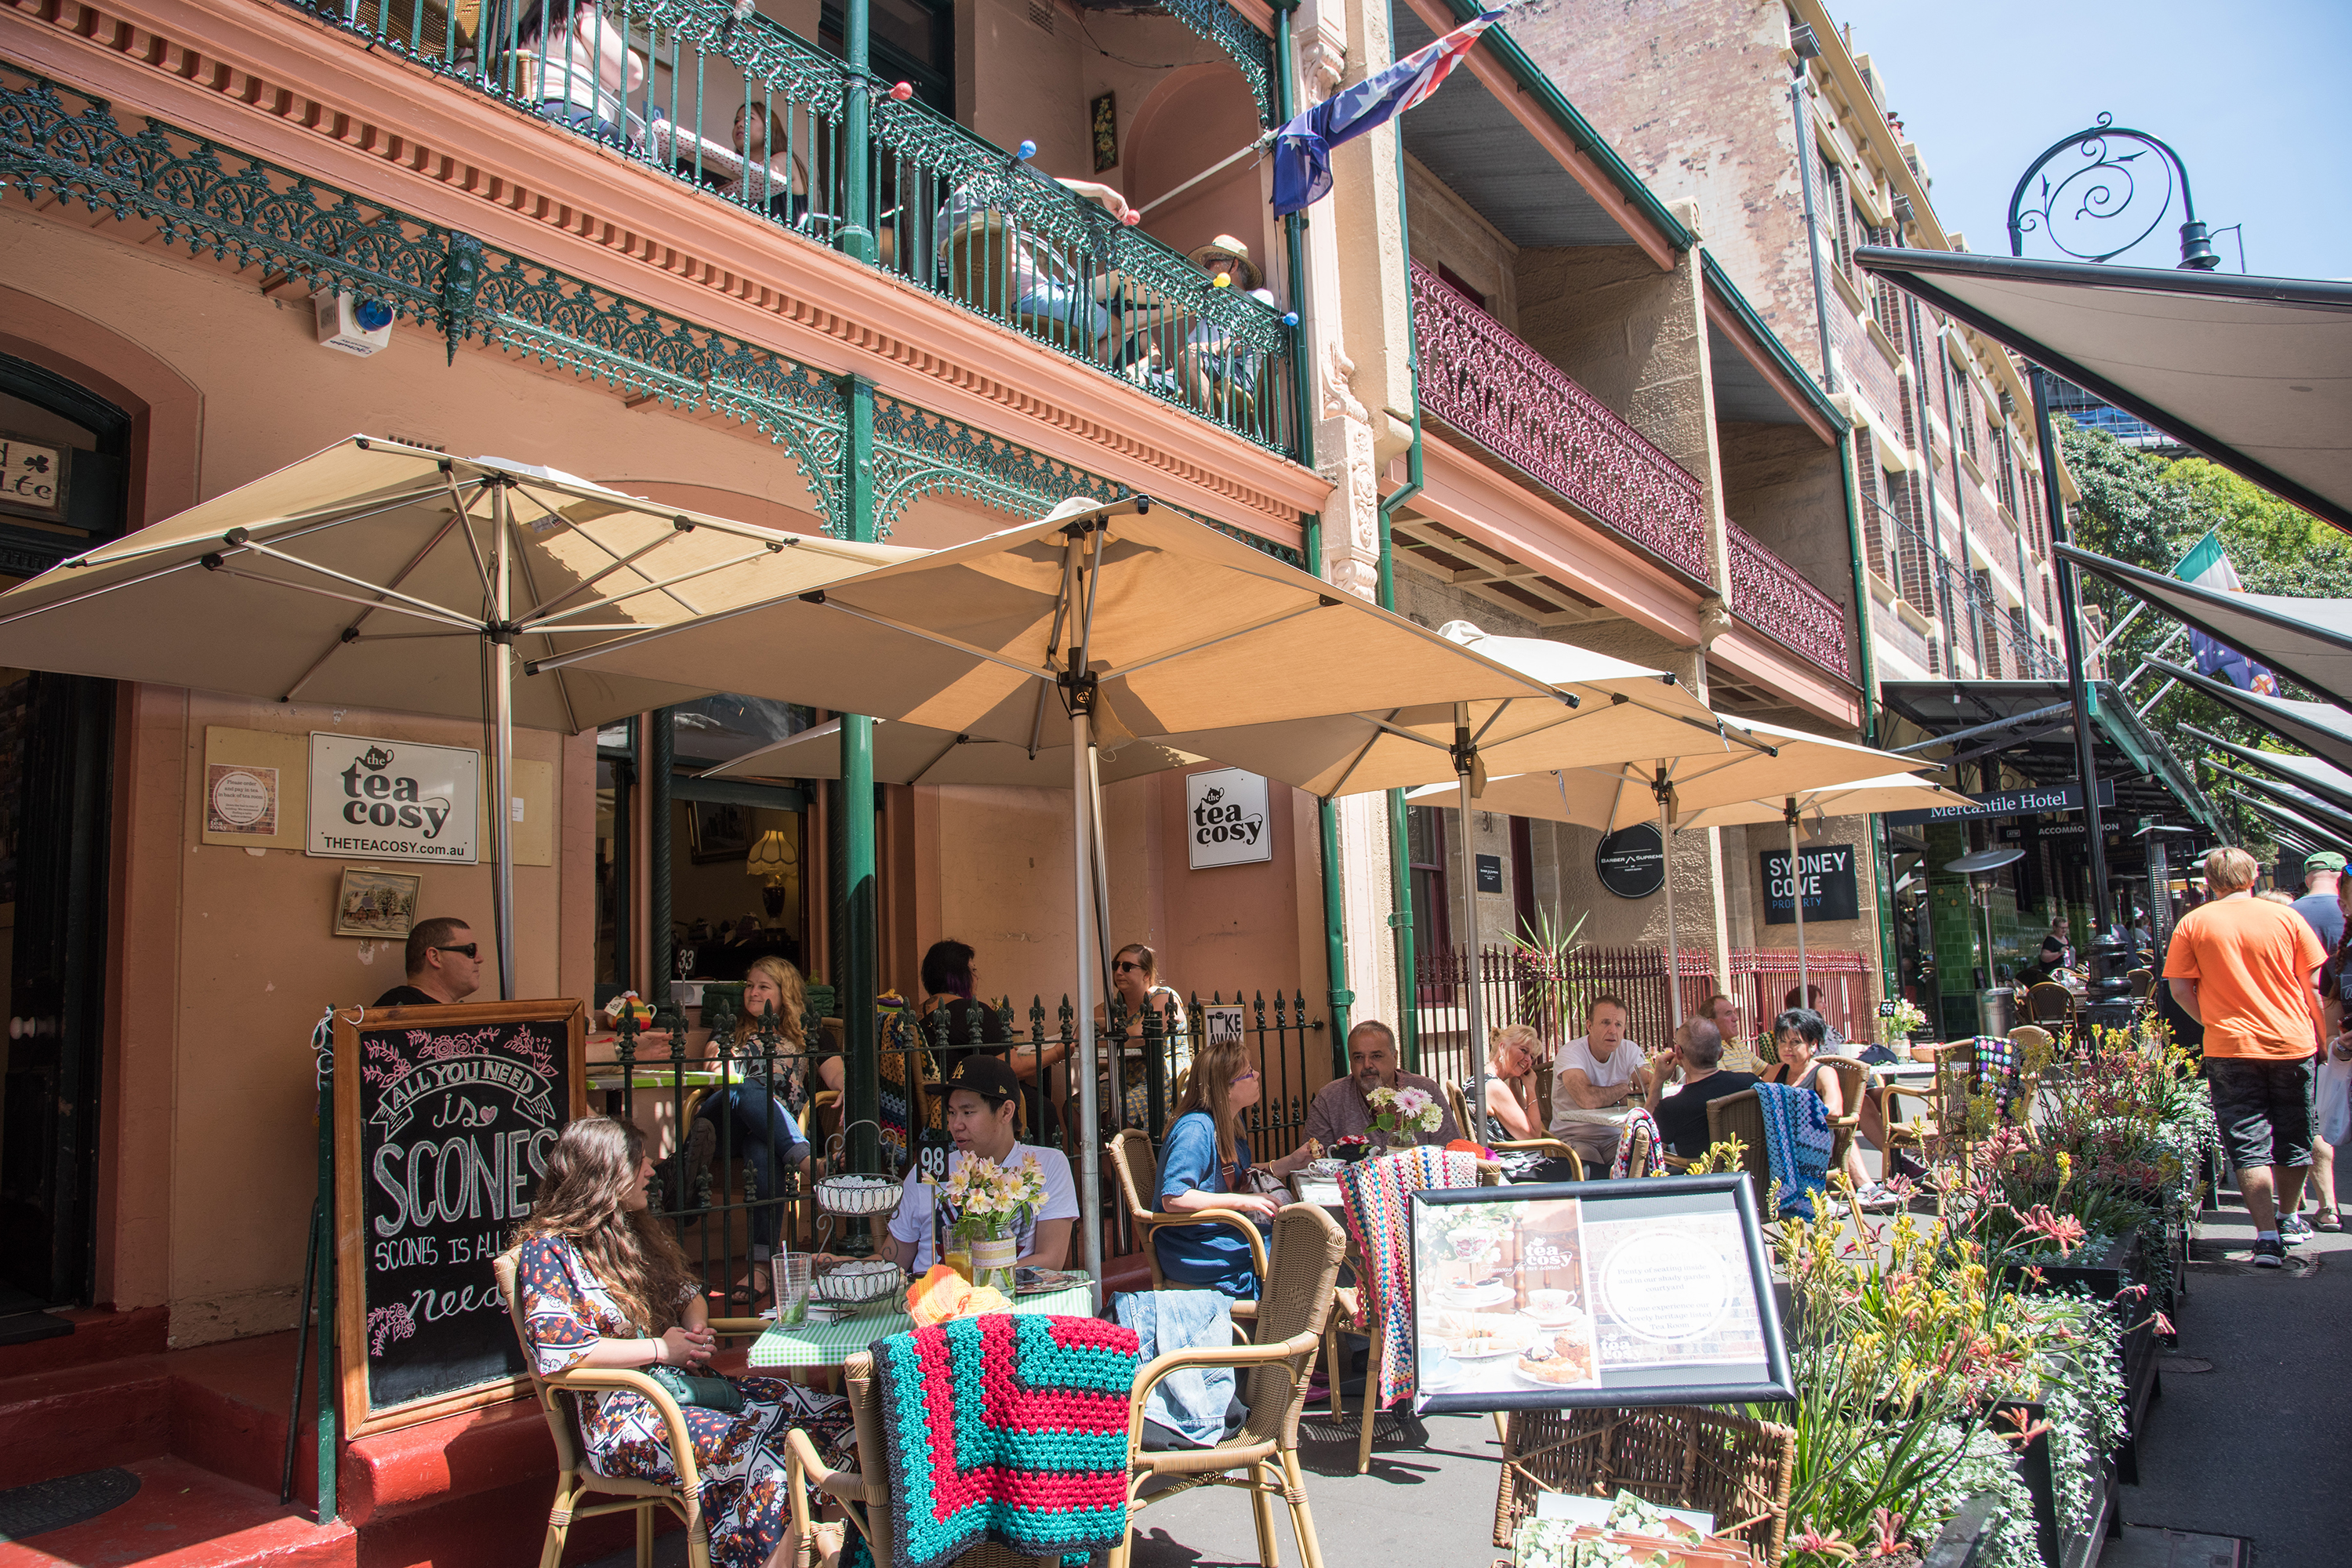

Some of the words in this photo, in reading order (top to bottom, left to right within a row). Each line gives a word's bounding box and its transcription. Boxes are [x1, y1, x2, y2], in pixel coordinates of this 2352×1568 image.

[366, 753, 386, 766] the
[341, 763, 419, 803] tea
[1208, 793, 1220, 801] the
[2020, 790, 2067, 809] Hotel
[343, 800, 450, 839] cosy
[1193, 802, 1242, 826] tea
[1483, 811, 1493, 833] 31
[1196, 820, 1262, 845] cosy
[2038, 822, 2119, 835] ACCOMMOION
[324, 837, 465, 856] THETEACOSY.com.au
[1769, 851, 1847, 877] SYDNEY
[1770, 875, 1822, 898] COVE
[1772, 897, 1822, 909] PROPRTY
[678, 949, 695, 971] 33
[1881, 1003, 1894, 1015] 55
[1207, 1012, 1241, 1033] TKE
[392, 1073, 431, 1110] ALL
[426, 1061, 480, 1087] YOU
[483, 1060, 535, 1094] NEED
[434, 1093, 481, 1128] is
[920, 1146, 945, 1176] 98
[374, 1236, 439, 1271] SCONES
[448, 1237, 470, 1264] IS
[476, 1231, 509, 1261] ALL
[1524, 1243, 1559, 1256] tea
[1480, 1264, 1512, 1275] Famous
[1505, 1261, 1526, 1277] for
[1526, 1254, 1573, 1267] cosy
[1653, 1265, 1682, 1273] seating
[1683, 1273, 1711, 1282] garden
[1645, 1284, 1685, 1293] courtyard
[1652, 1303, 1694, 1312] experience
[1655, 1312, 1688, 1321] heritage
[1599, 1338, 1632, 1351] tea
